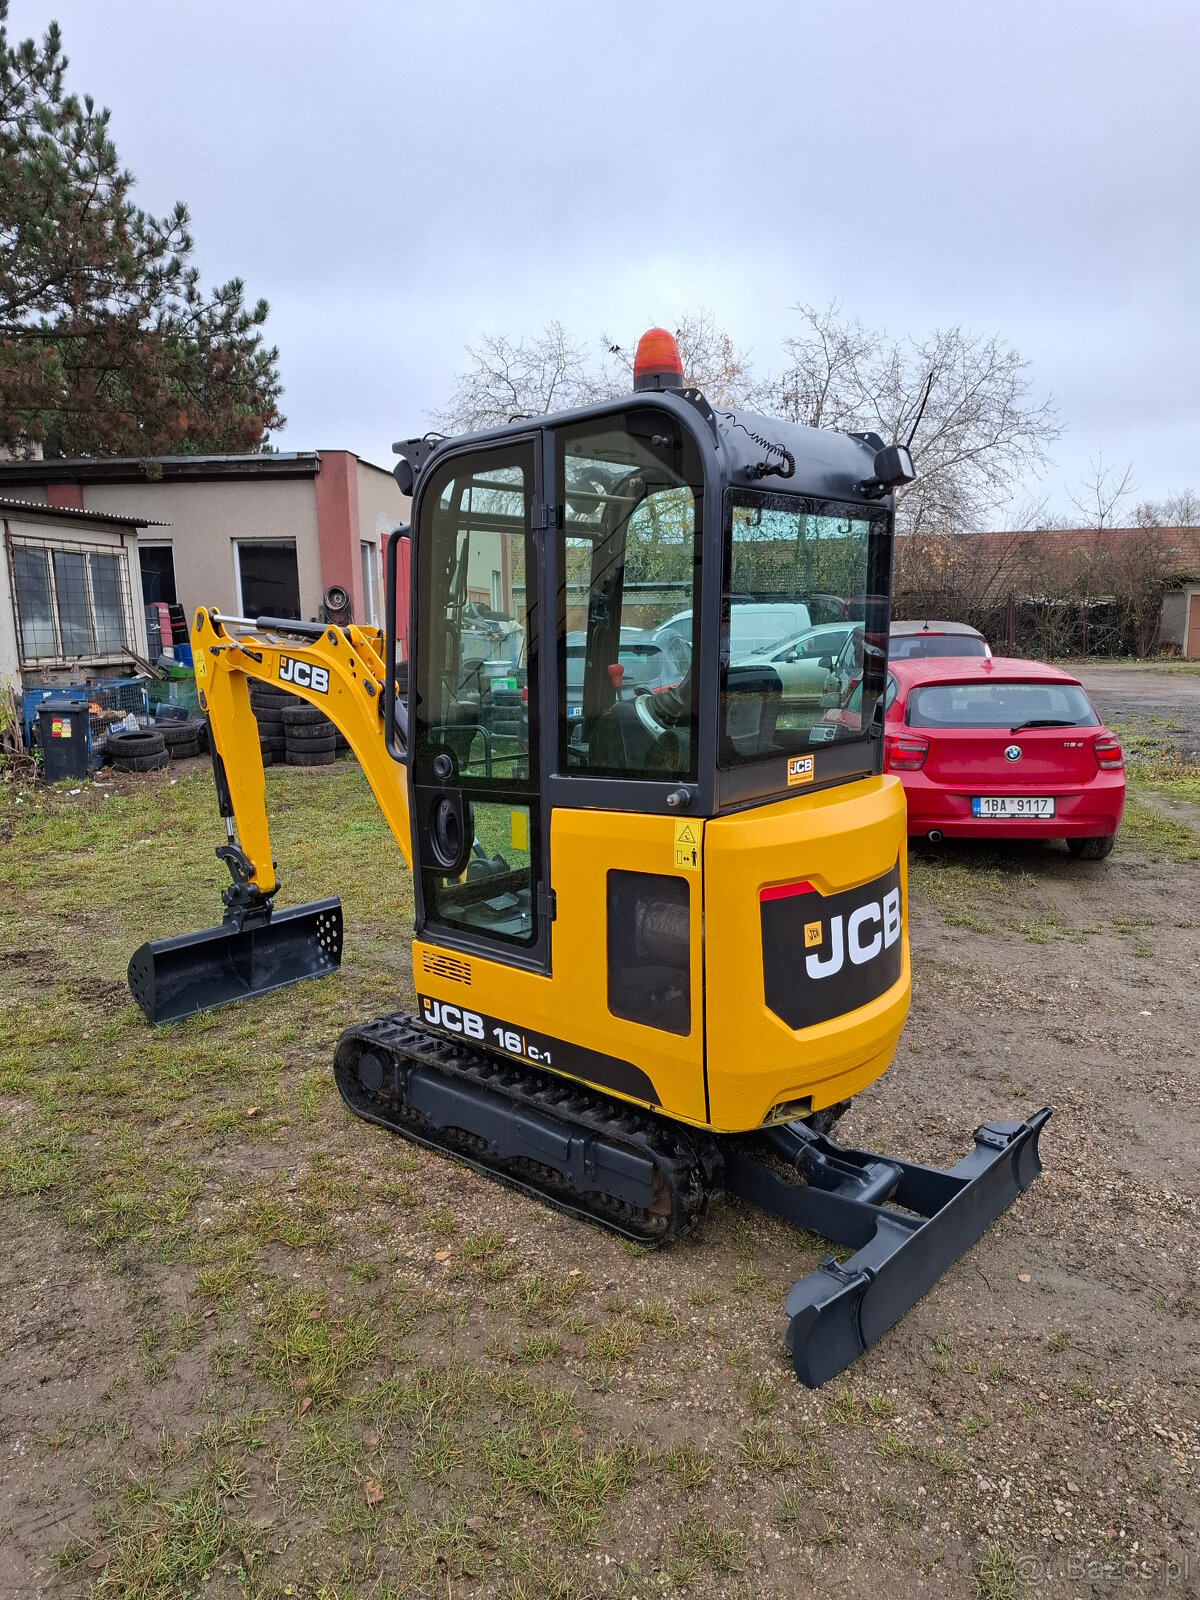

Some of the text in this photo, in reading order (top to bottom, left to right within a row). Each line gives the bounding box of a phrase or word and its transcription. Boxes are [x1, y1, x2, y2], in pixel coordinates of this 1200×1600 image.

[280, 659, 328, 692] JCB
[790, 759, 812, 774] JCB
[984, 799, 1007, 812] 1BA
[1017, 799, 1048, 812] 9117
[805, 887, 900, 979] JCB
[424, 1001, 485, 1040] JCB
[493, 1027, 522, 1054] 16
